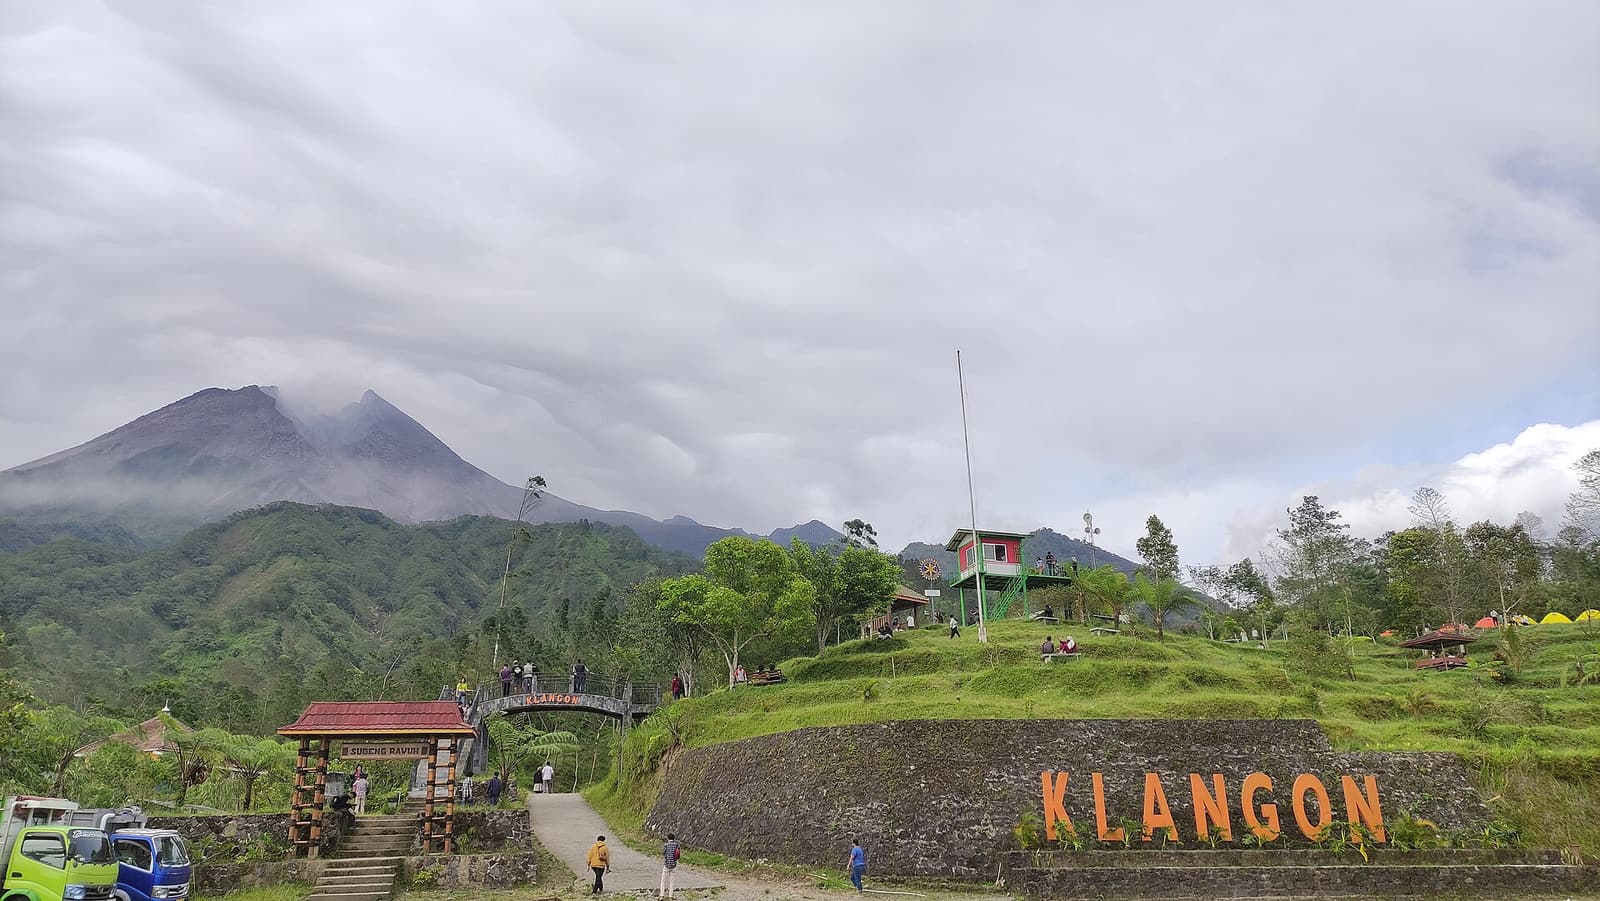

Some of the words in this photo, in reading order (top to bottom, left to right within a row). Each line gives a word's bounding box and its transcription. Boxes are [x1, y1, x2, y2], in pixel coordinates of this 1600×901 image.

[526, 694, 579, 705] KLANGON
[350, 747, 387, 755] SUGENG
[1041, 771, 1386, 843] KLANGON
